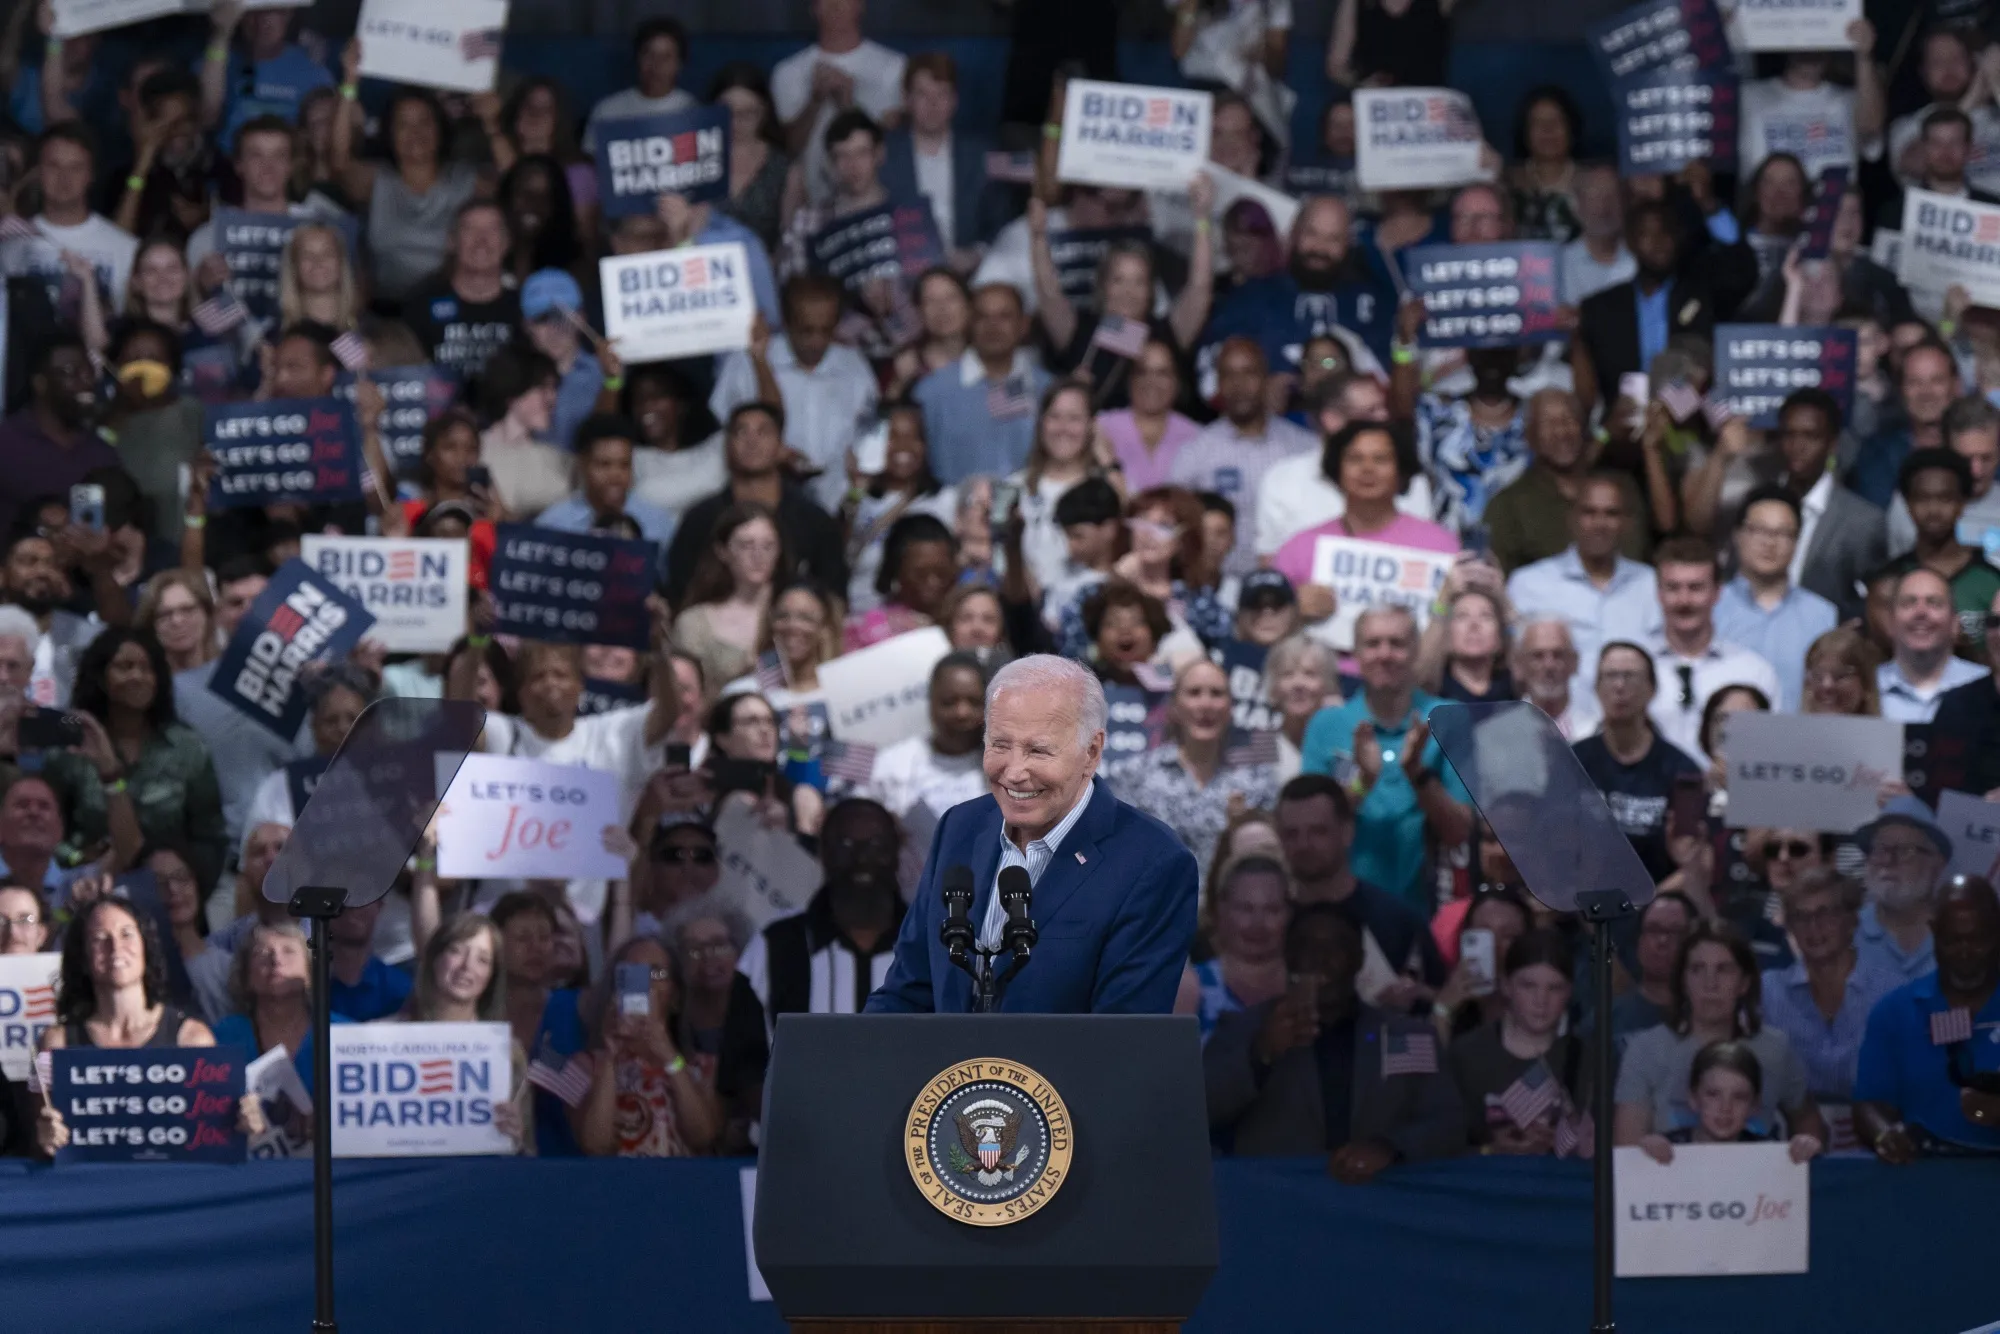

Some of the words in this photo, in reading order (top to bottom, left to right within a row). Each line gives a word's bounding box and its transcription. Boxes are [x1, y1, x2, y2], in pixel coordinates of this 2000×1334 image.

[1082, 91, 1198, 126] BIDEN
[607, 126, 723, 169] BIDEN
[1078, 125, 1196, 153] HARRIS
[612, 155, 723, 197] HARRIS
[1918, 201, 2000, 245] BIDE
[619, 255, 734, 294] BIDEN
[1421, 259, 1482, 283] LET'S
[1483, 257, 1518, 279] GO
[622, 284, 737, 320] HARRIS
[1423, 287, 1485, 312] LET'S
[1486, 285, 1520, 308] GO
[1425, 315, 1487, 338] LET'S
[1488, 313, 1522, 334] GO
[1728, 340, 1788, 360] LET'S
[1789, 340, 1822, 360] GO
[1729, 367, 1788, 387] LET'S
[1789, 367, 1822, 387] GO
[215, 416, 273, 439] LET'S
[273, 414, 308, 435] GO
[213, 444, 277, 467] LET'S
[277, 442, 311, 463] GO
[221, 472, 281, 494] LET'S
[281, 470, 315, 491] GO
[317, 548, 447, 581] BIDEN
[505, 538, 570, 568] LET'S
[570, 548, 608, 571] GO
[345, 582, 446, 608] ARRIS
[499, 568, 565, 597] LET'S
[566, 579, 603, 601] GO
[562, 608, 598, 631] GO
[234, 581, 327, 703] BIDEN
[259, 600, 347, 718] HARRIS
[1738, 761, 1806, 783] LET'S
[1810, 764, 1847, 784] GO
[470, 780, 544, 803] LET'S
[548, 785, 588, 806] GO
[485, 804, 572, 861] Joe
[70, 1065, 143, 1085] LET'S
[147, 1064, 186, 1084] GO
[184, 1057, 232, 1088] Joe
[337, 1060, 490, 1095] BIDEN
[989, 1066, 1004, 1076] OF
[1008, 1069, 1029, 1085] THE
[71, 1097, 144, 1115] LET'S
[147, 1095, 187, 1114] GO
[184, 1089, 232, 1120] Joe
[337, 1098, 492, 1127] HARRIS
[910, 1064, 984, 1139] PRESIDENT
[1032, 1083, 1068, 1151] UNITED
[72, 1127, 144, 1145] LET'S
[148, 1126, 187, 1145] GO
[913, 1145, 925, 1168] THE
[919, 1171, 933, 1185] OF
[1004, 1166, 1061, 1218] STATES
[932, 1184, 975, 1218] SEAL
[1630, 1201, 1702, 1221] LET'S
[1708, 1200, 1746, 1220] GO
[1745, 1193, 1792, 1226] Joe
